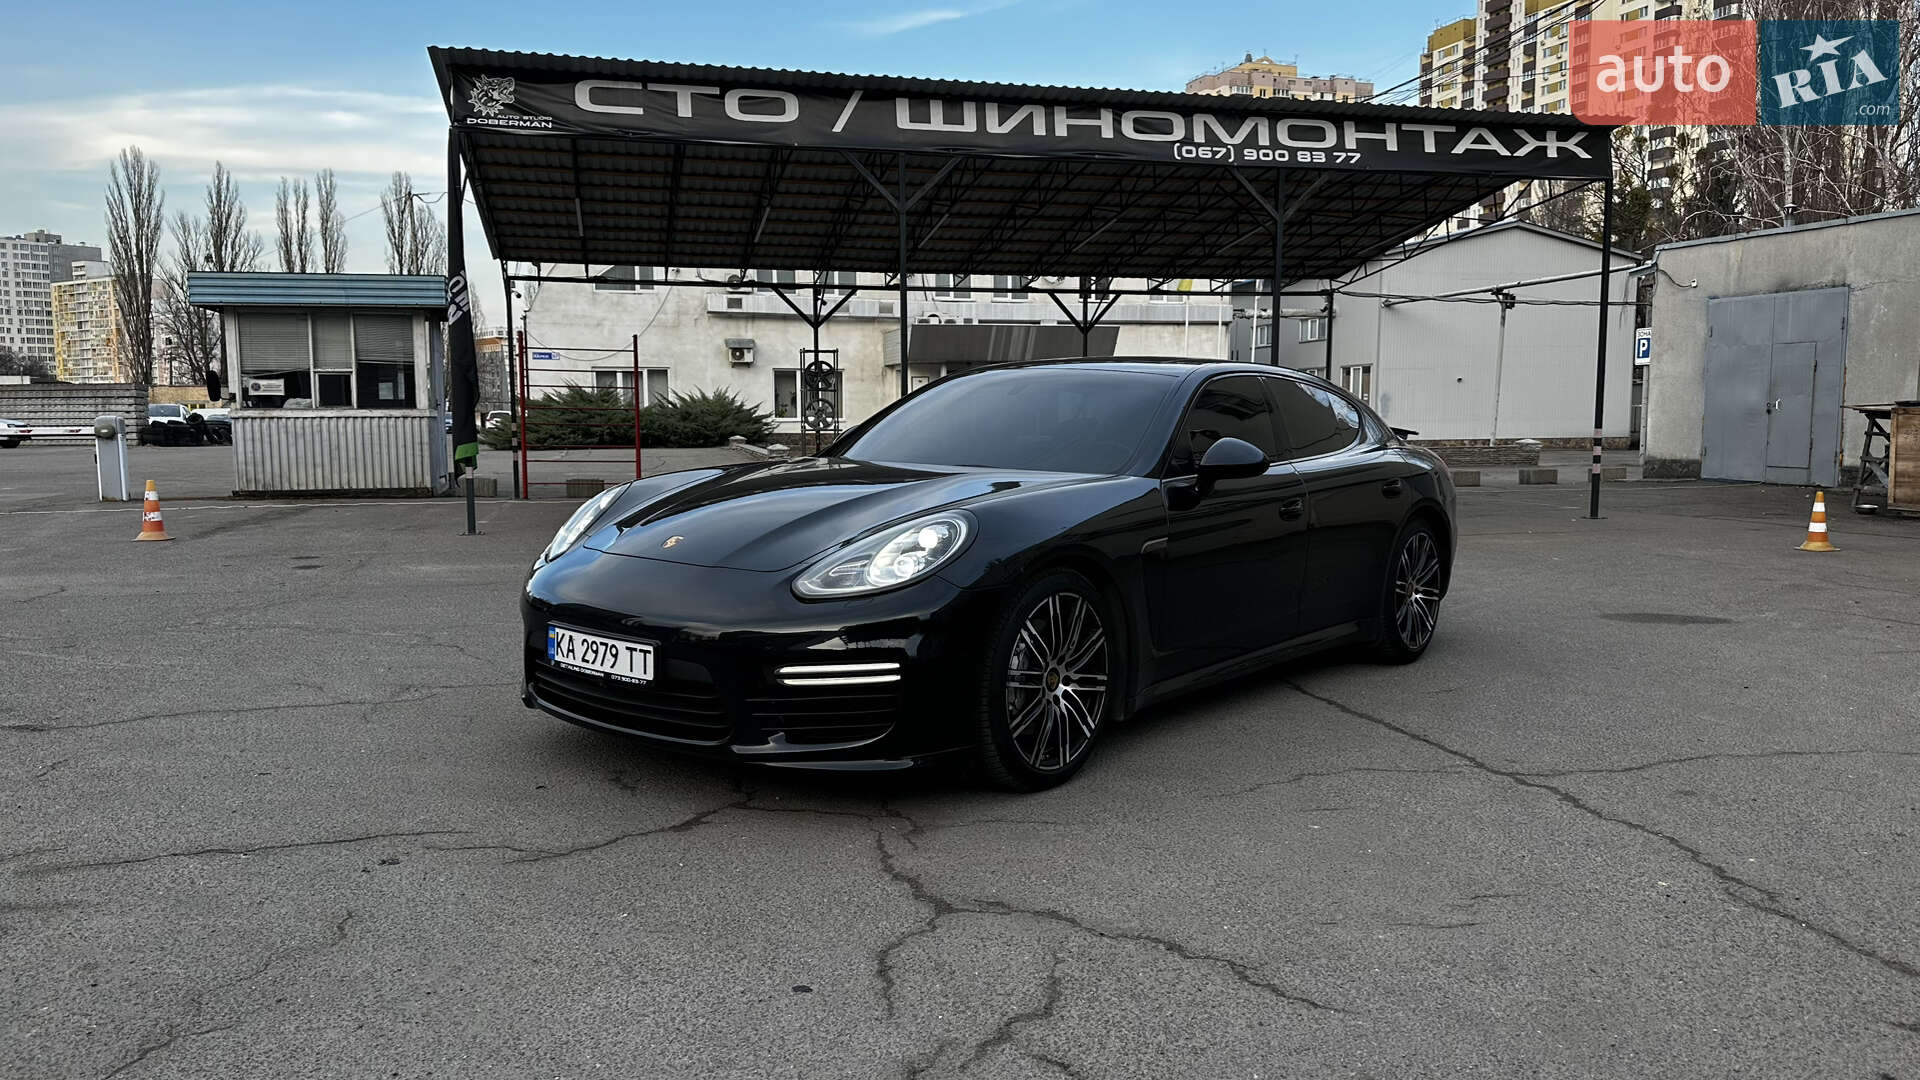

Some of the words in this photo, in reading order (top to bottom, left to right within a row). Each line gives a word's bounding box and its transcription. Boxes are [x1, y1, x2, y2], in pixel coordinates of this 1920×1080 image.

[467, 118, 552, 128] DOBERMAN
[574, 79, 799, 122] СТО
[895, 97, 1592, 159] ШИНОМОНТАЖ
[1173, 142, 1234, 162] (067)
[1244, 149, 1289, 161] 900
[1297, 151, 1326, 163] 83
[1333, 152, 1361, 163] 77
[1640, 340, 1648, 357] P
[556, 632, 576, 660] KA
[581, 638, 619, 669] 2979
[625, 646, 652, 675] TT
